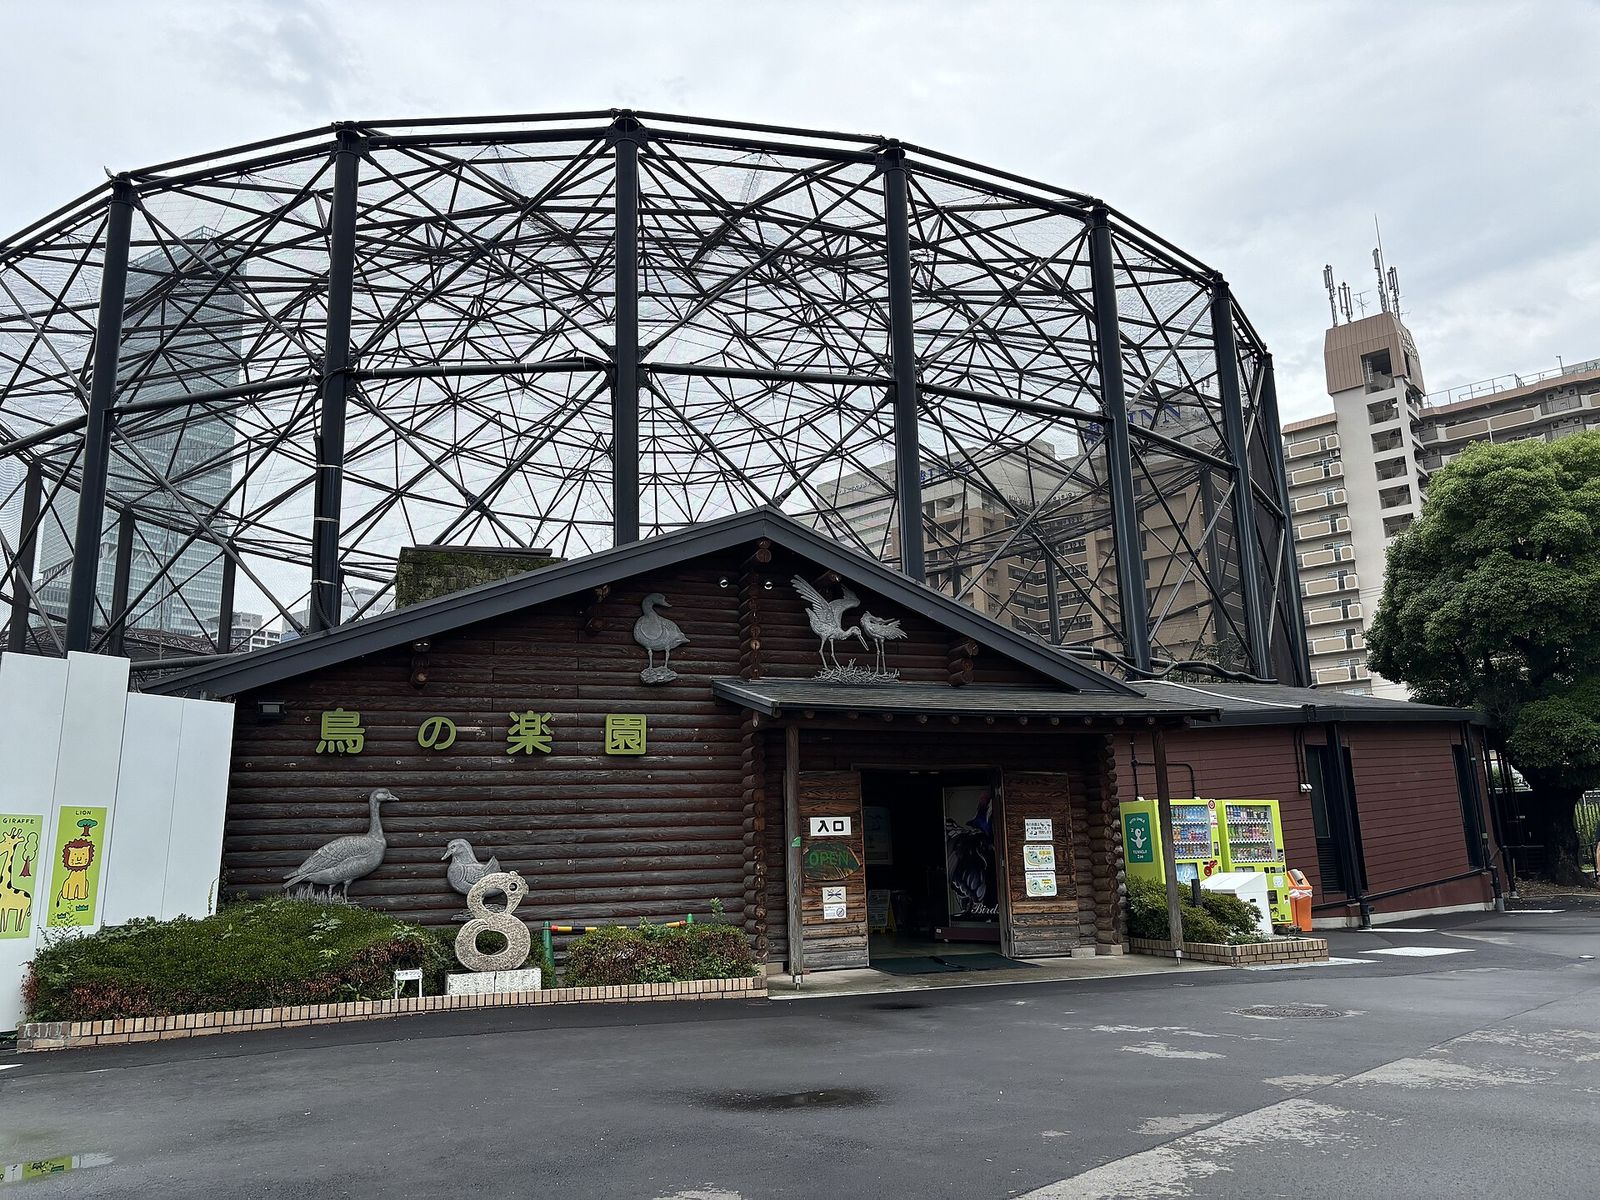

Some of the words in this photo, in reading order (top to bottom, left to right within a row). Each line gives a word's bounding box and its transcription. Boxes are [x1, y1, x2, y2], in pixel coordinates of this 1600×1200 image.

[316, 708, 647, 754] 鳥の楽園
[817, 820, 844, 832] 入口
[809, 849, 849, 867] OPEN
